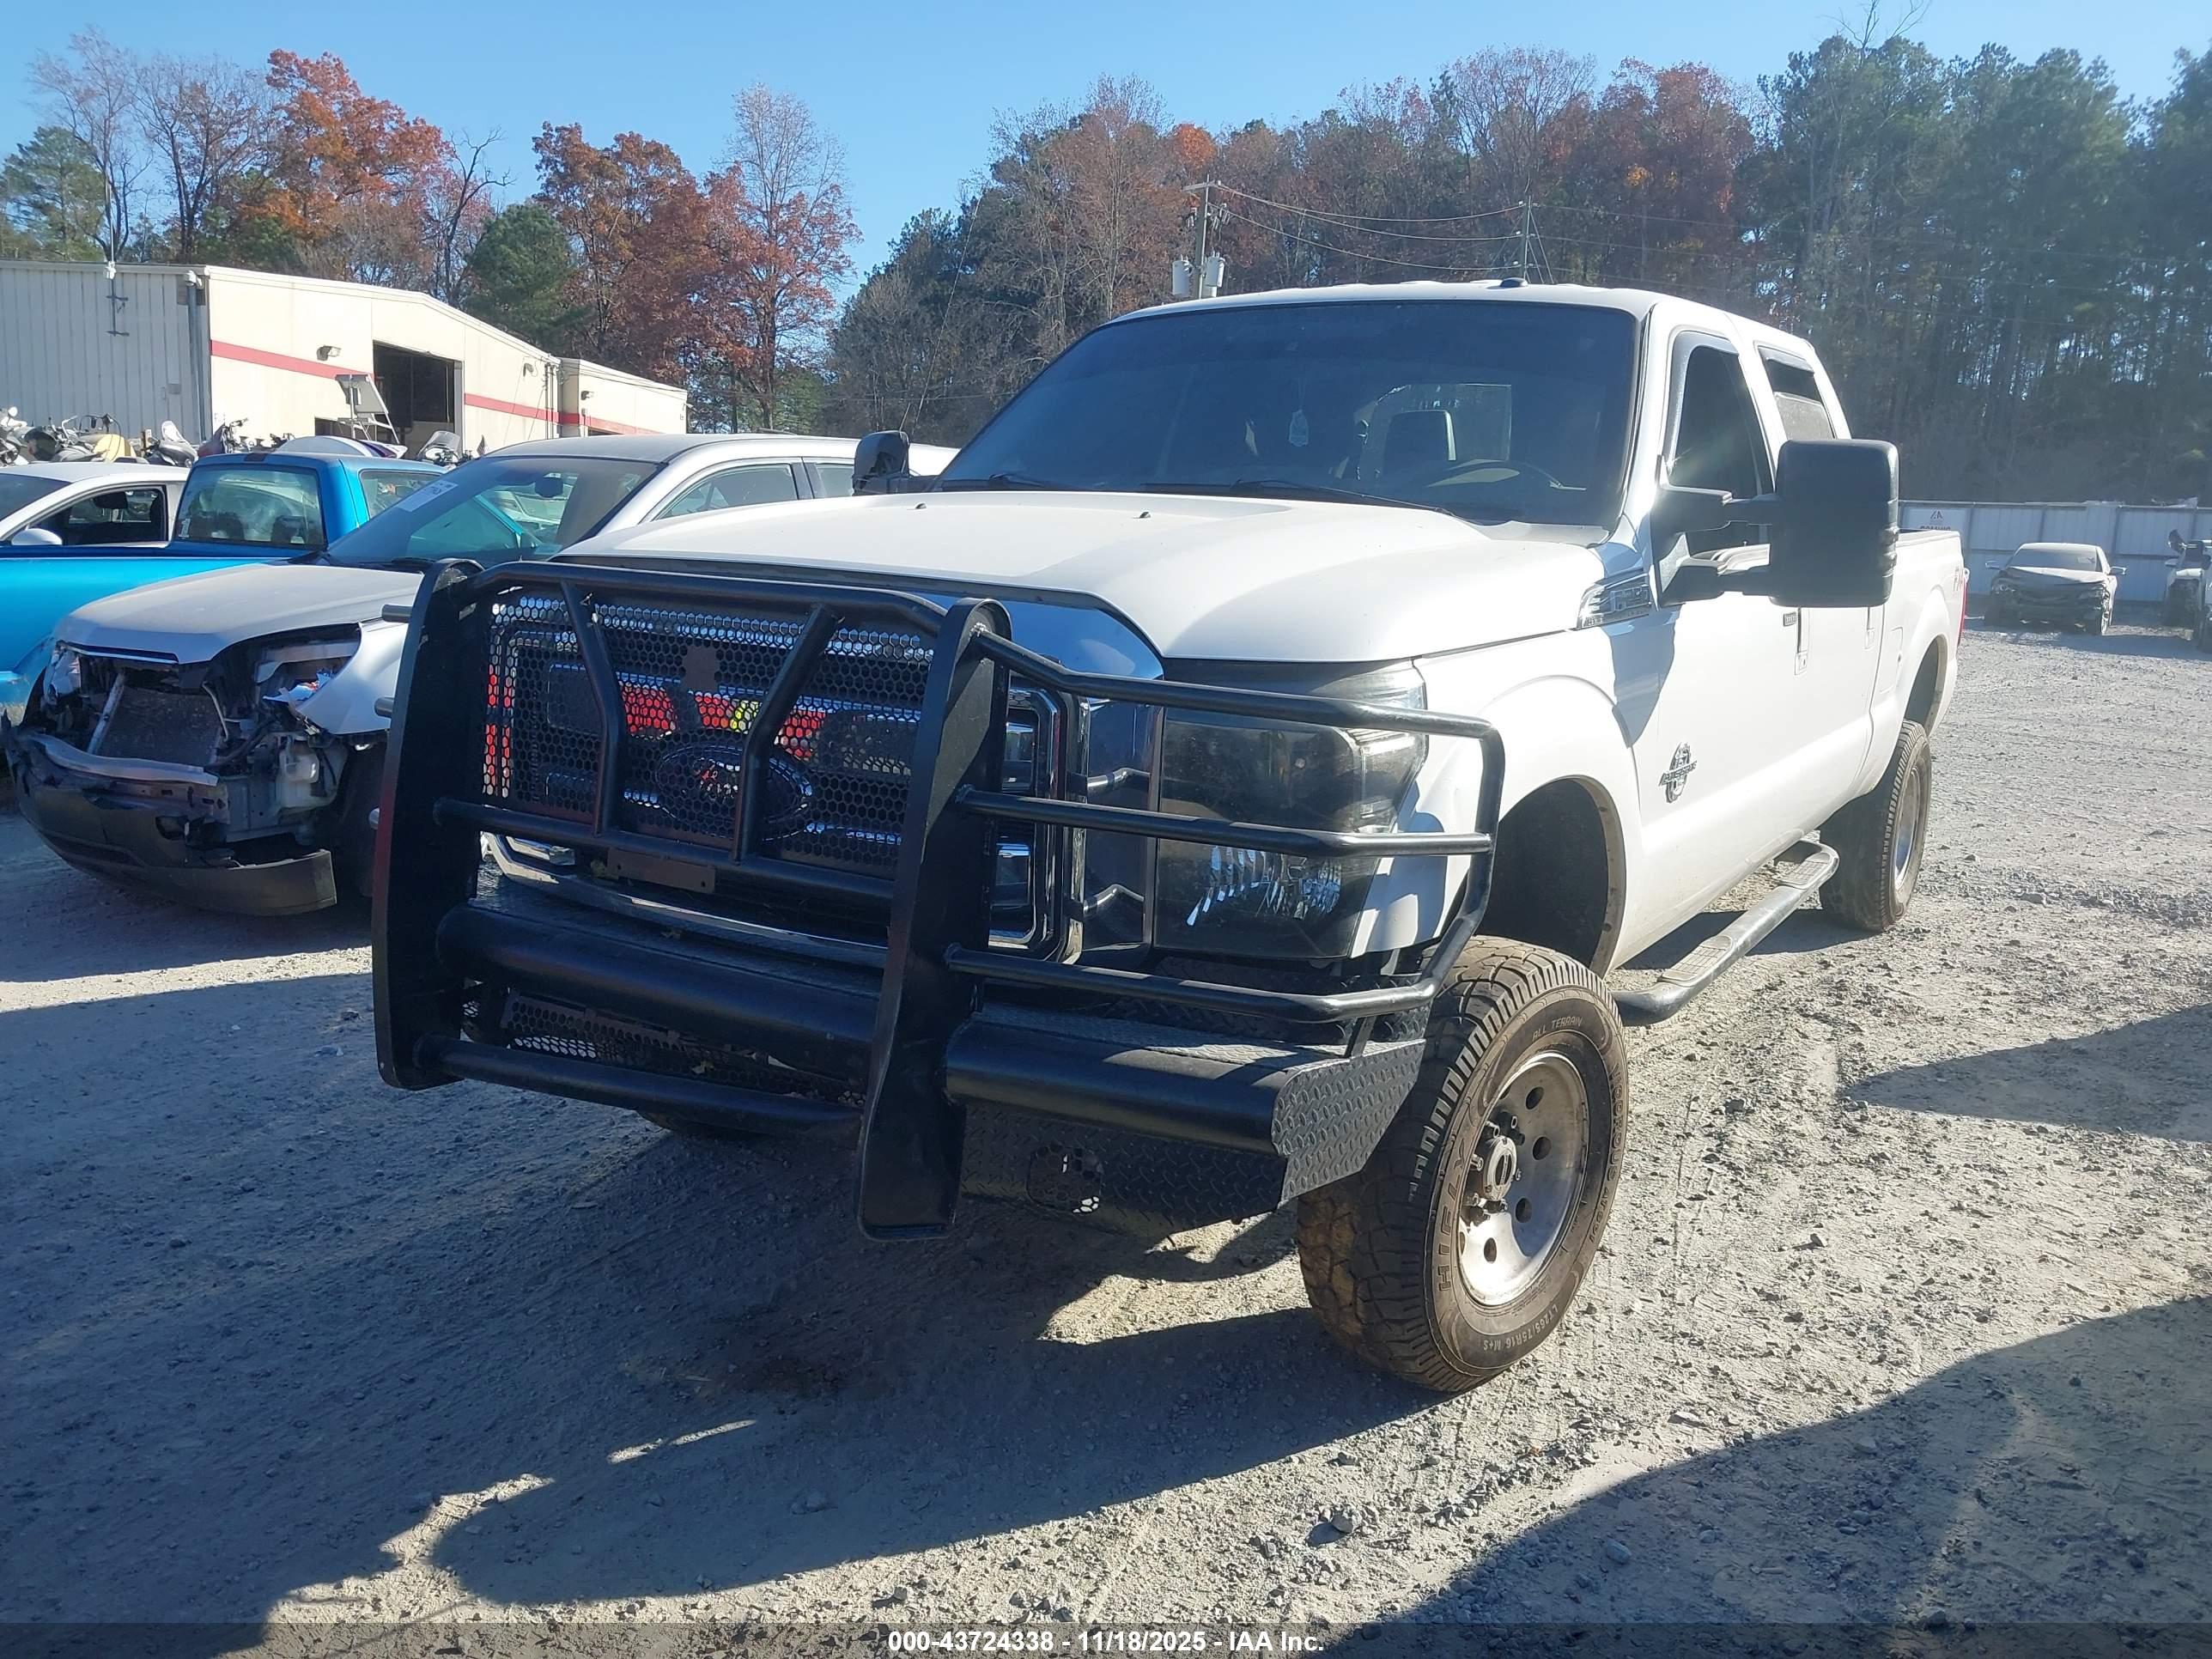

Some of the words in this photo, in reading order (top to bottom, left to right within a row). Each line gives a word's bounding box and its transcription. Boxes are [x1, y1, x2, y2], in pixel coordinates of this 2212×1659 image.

[1532, 1024, 1547, 1042] ALL
[1551, 1016, 1583, 1030] TERRAIN
[1437, 1139, 1465, 1291] HIFLY
